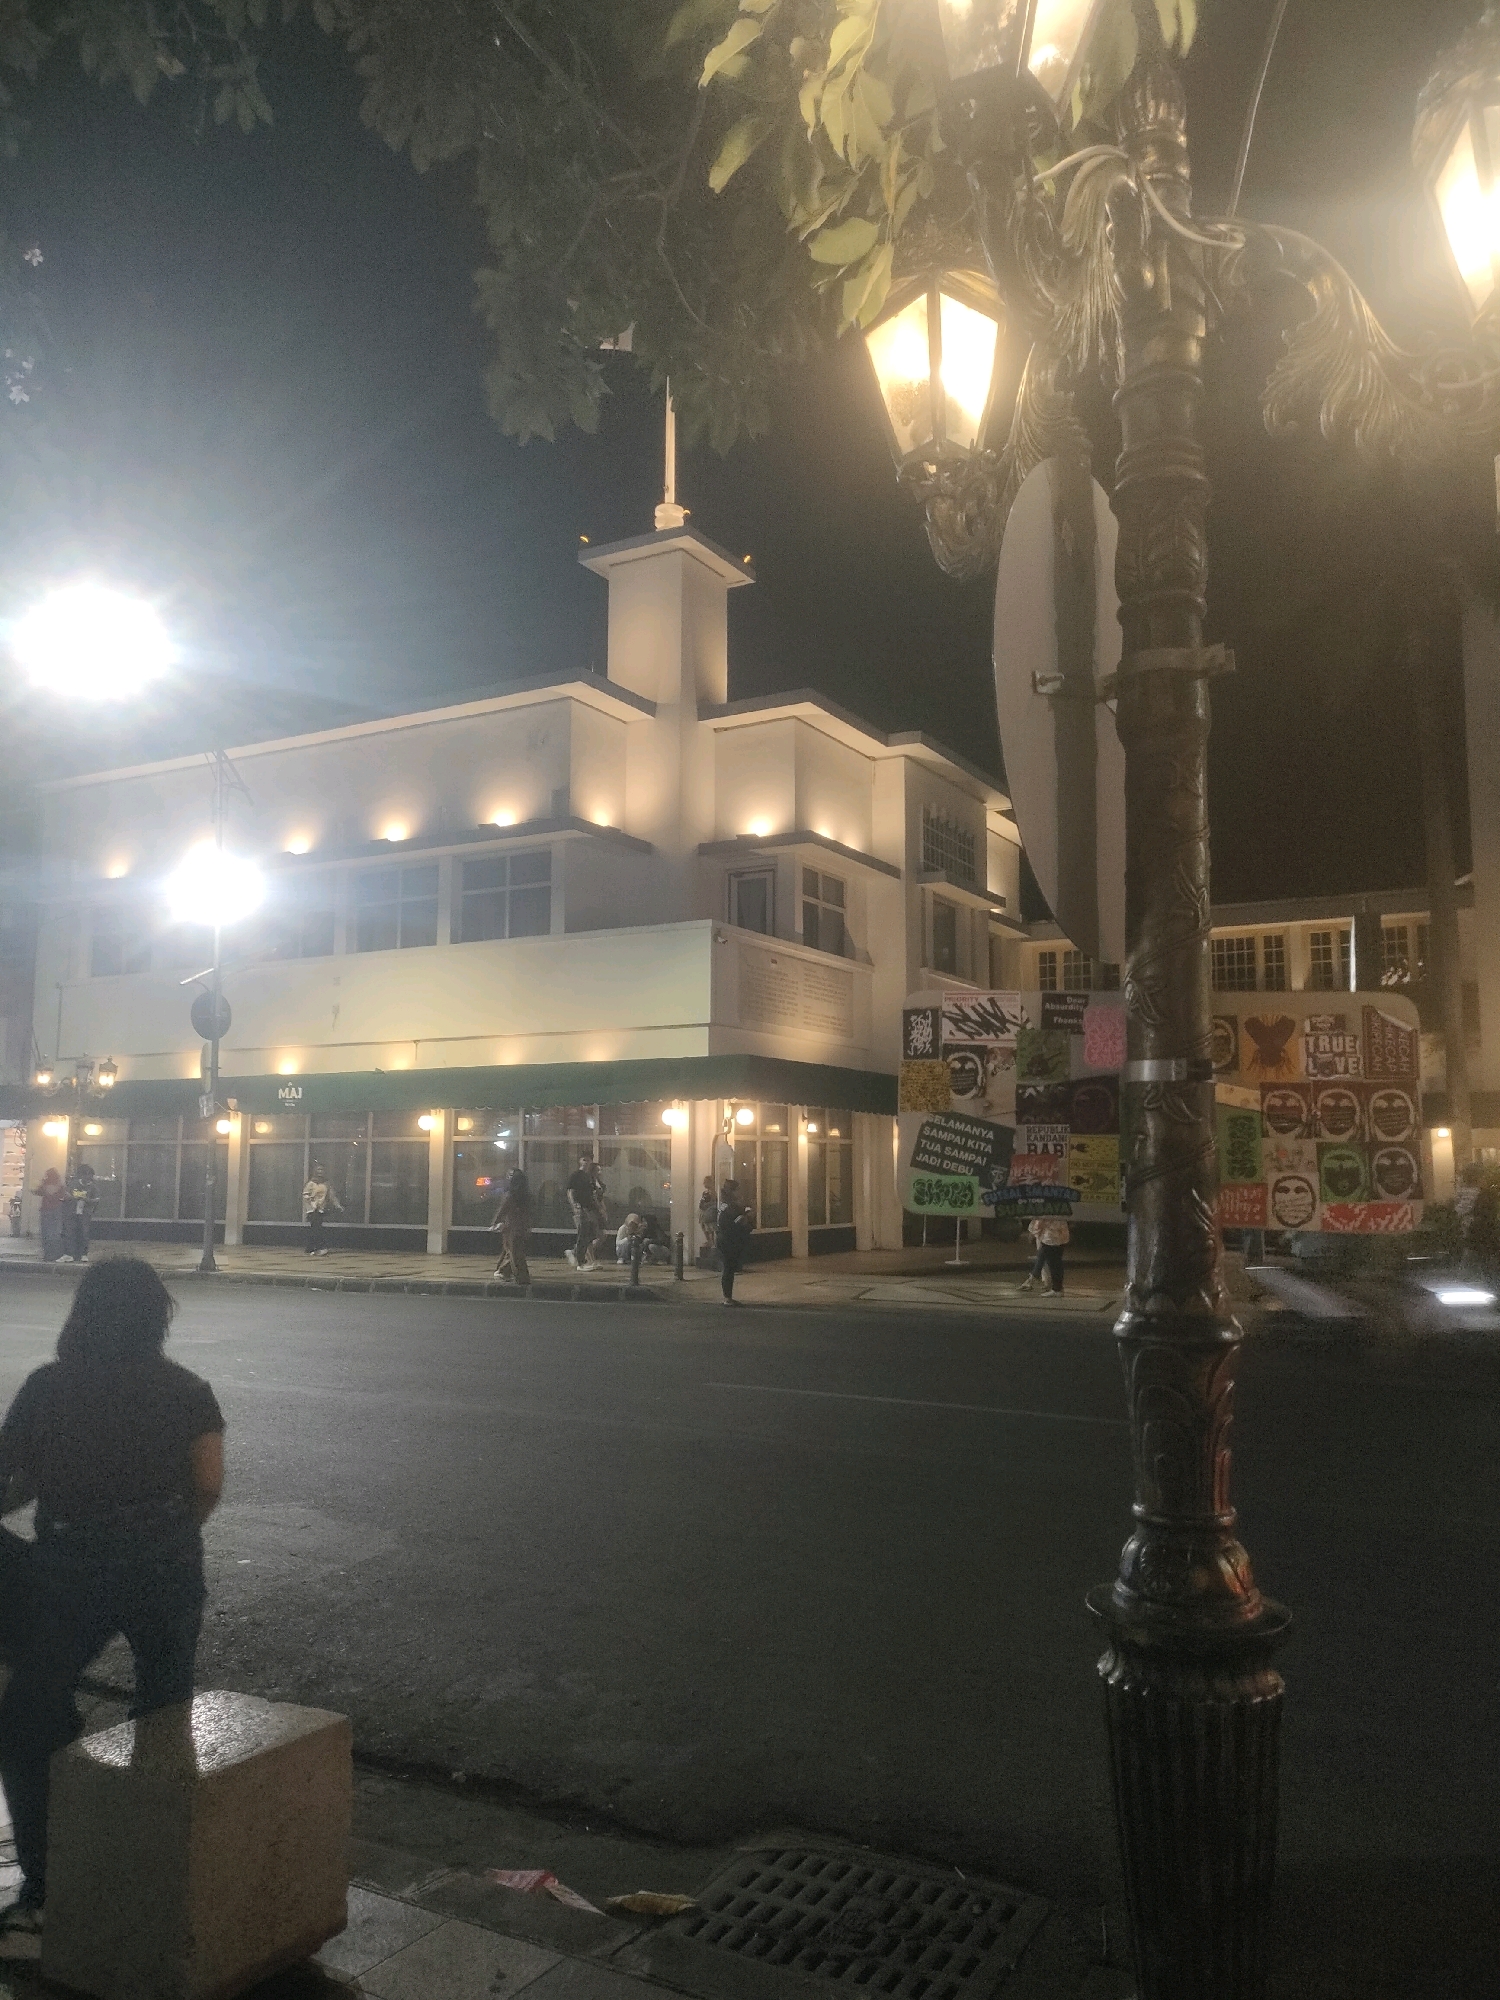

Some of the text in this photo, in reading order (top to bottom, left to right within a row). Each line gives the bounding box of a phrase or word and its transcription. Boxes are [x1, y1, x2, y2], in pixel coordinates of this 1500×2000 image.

[1305, 1035, 1356, 1053] TRUE
[1307, 1056, 1358, 1075] LVE
[278, 1087, 303, 1099] MAJ
[927, 1113, 994, 1140] SELAMANYA
[1026, 1125, 1070, 1134] REPUBLIK
[923, 1126, 992, 1154] SAMPAI KITA
[920, 1138, 987, 1166] TUA SAMPAI
[916, 1153, 974, 1175] JADI DEBU
